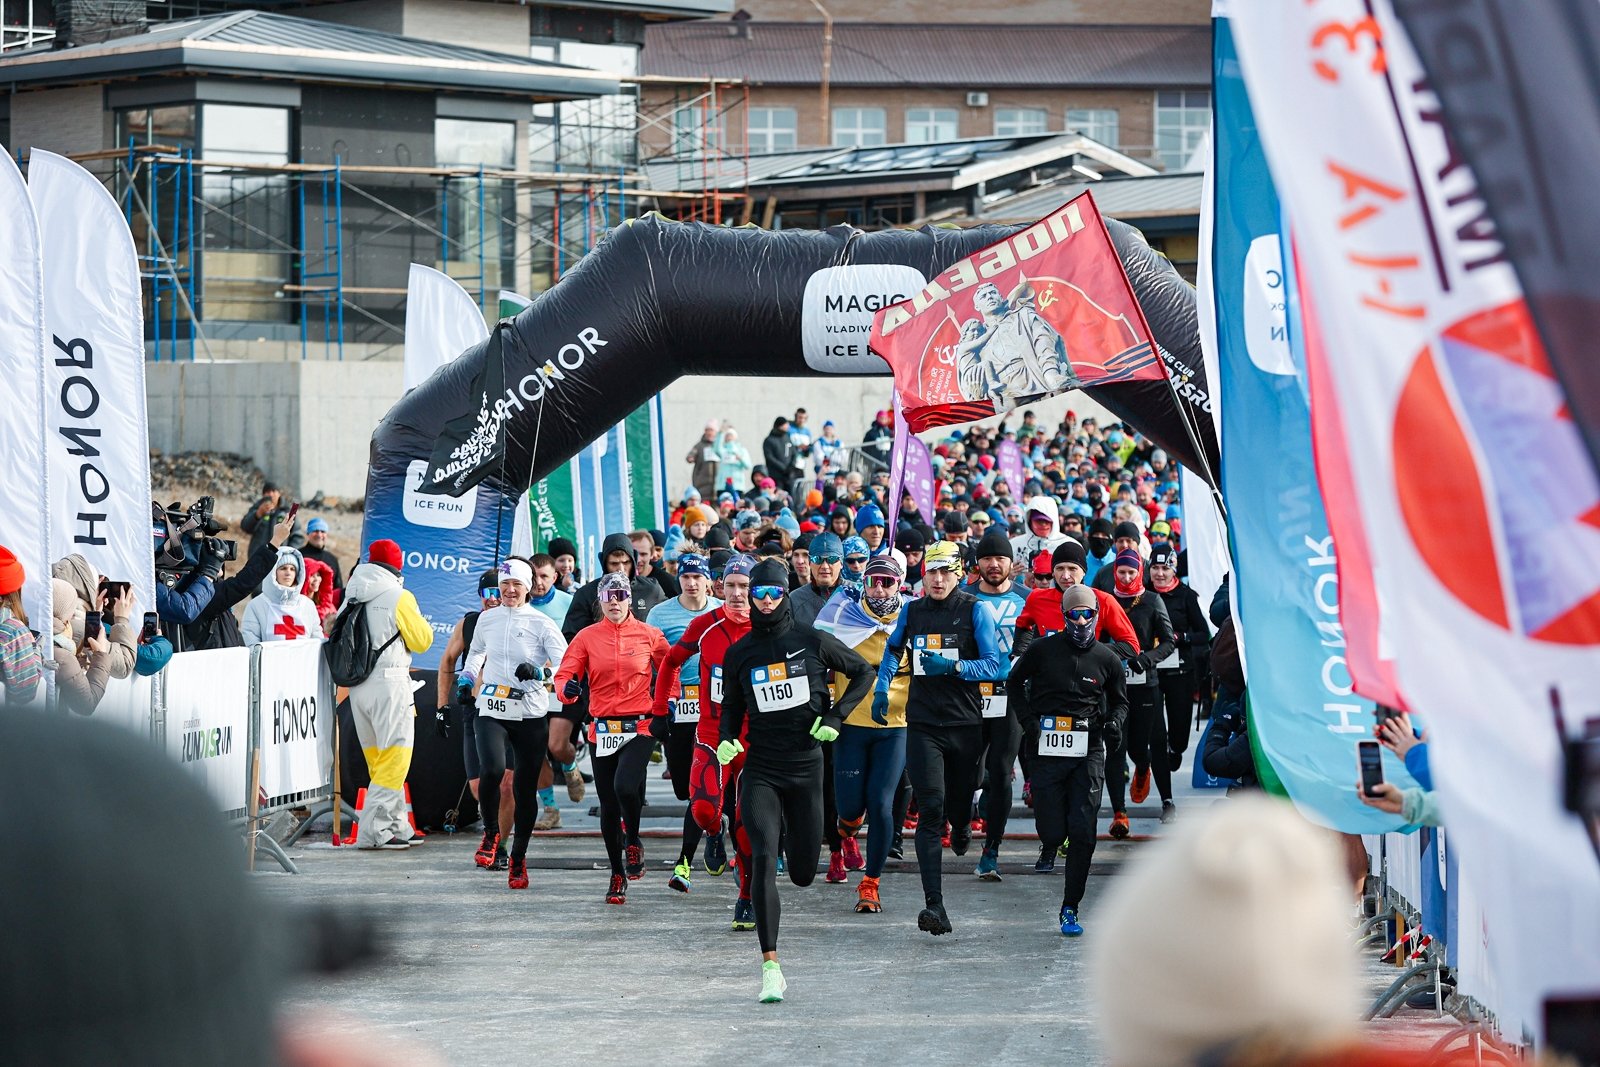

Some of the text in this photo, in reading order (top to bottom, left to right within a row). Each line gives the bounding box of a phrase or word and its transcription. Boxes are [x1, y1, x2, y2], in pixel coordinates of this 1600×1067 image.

[825, 345, 859, 357] ICE
[503, 326, 609, 420] HONOR
[1173, 361, 1195, 378] CLUB
[414, 499, 463, 512] ICE RUN
[760, 682, 793, 702] 1150
[487, 698, 506, 713] 945
[273, 696, 317, 745] HONOR
[1045, 733, 1074, 748] 1019
